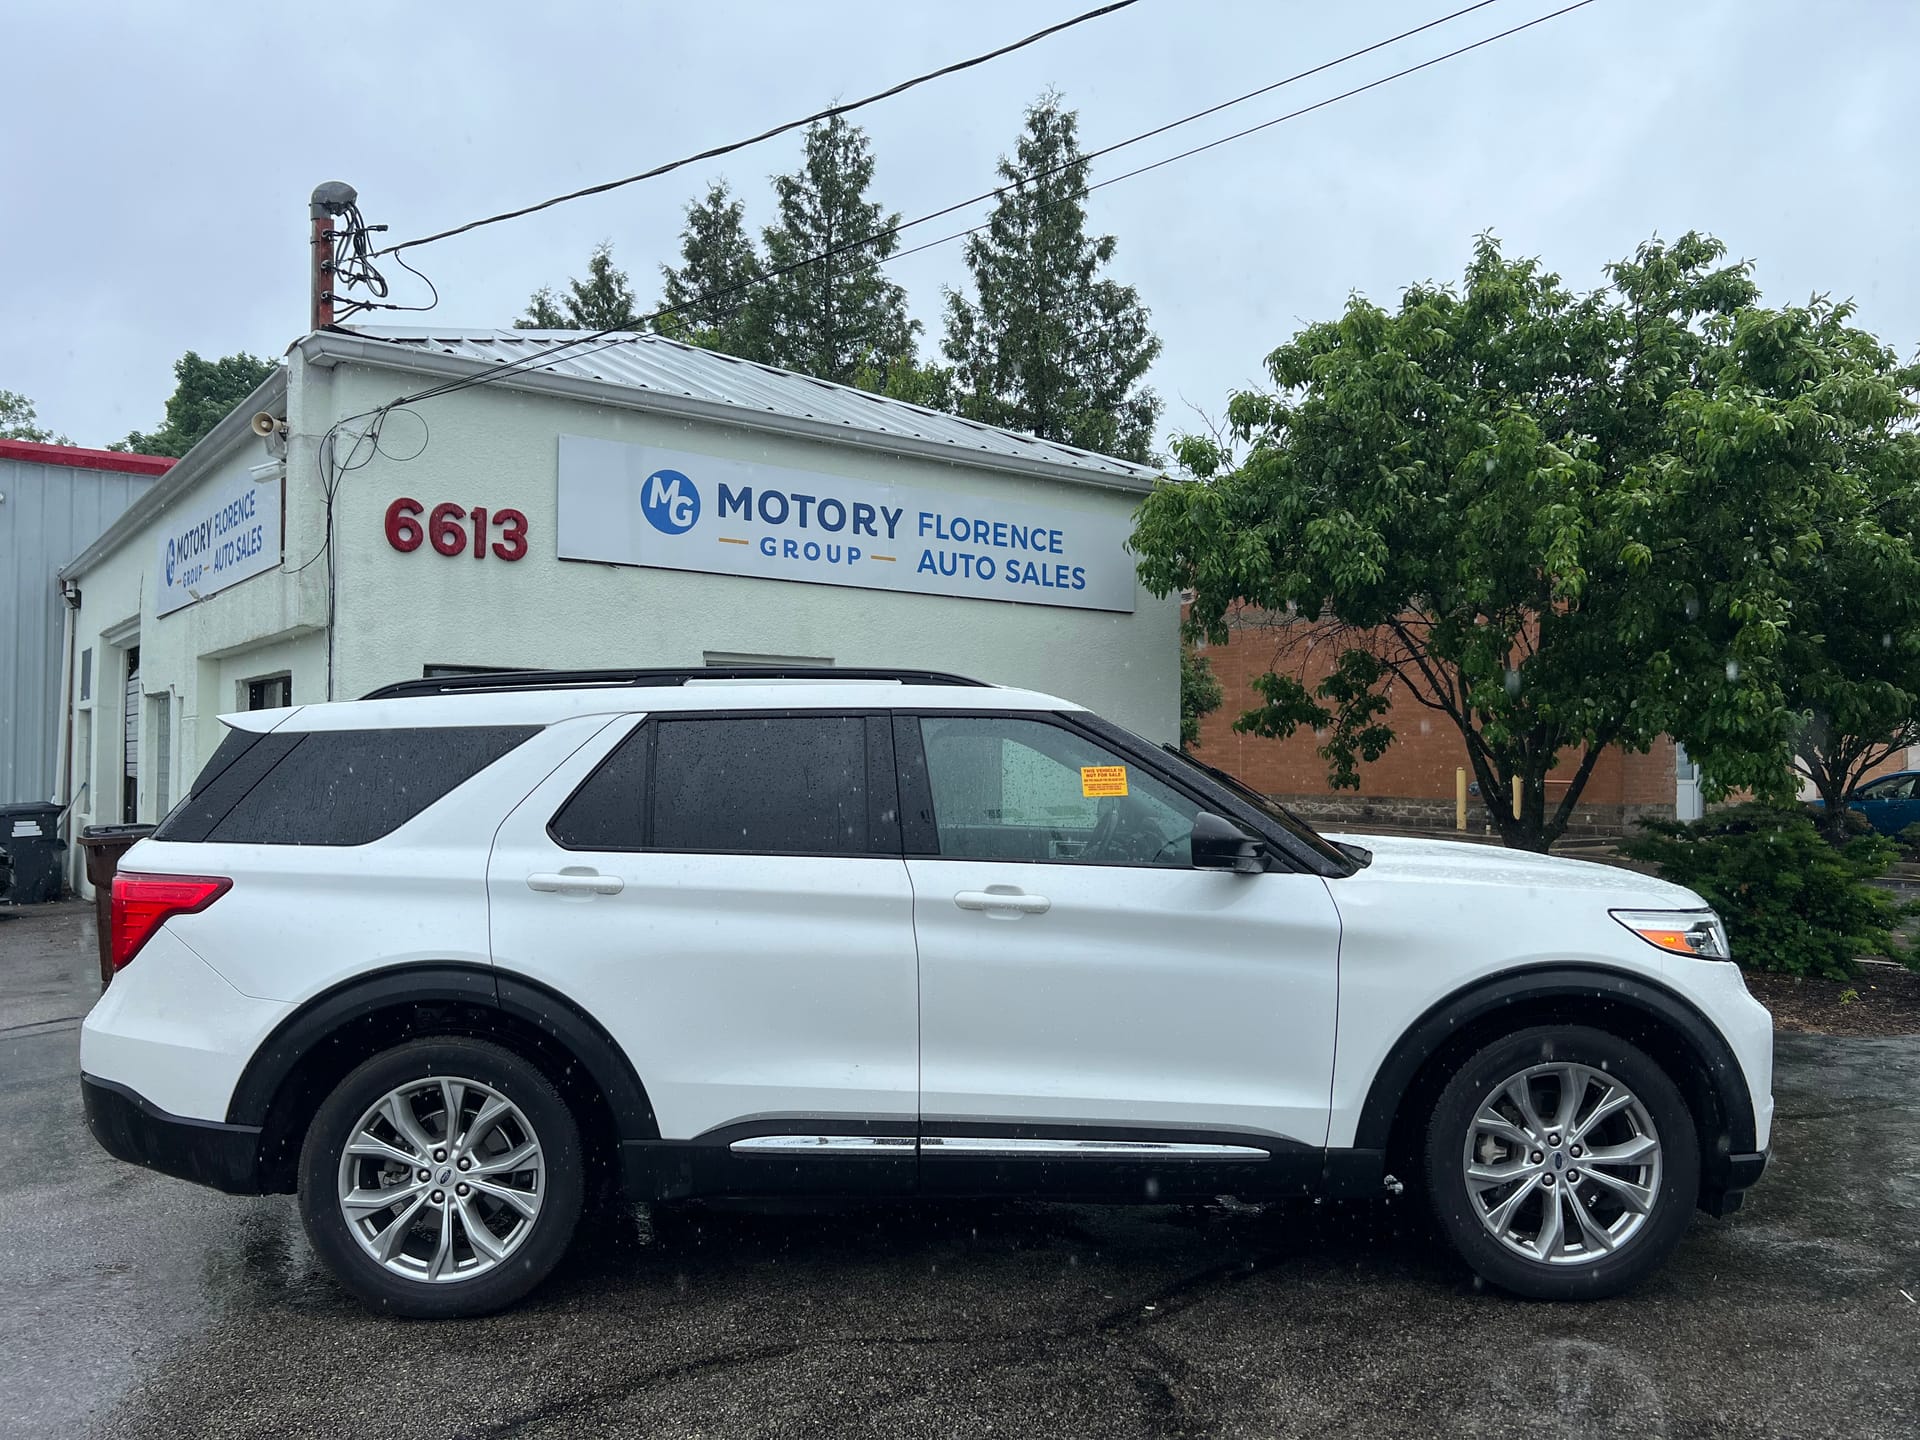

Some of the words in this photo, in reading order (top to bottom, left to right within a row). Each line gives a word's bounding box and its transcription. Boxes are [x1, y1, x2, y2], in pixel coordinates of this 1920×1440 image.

[214, 489, 256, 538] FLORENCE
[648, 476, 694, 527] MG
[718, 483, 904, 539] MOTORY
[176, 517, 213, 565] MOTORY
[213, 540, 234, 574] AUTO
[236, 525, 263, 562] SALES
[384, 497, 529, 562] 6613
[759, 536, 862, 565] GROUP
[918, 511, 1063, 554] FLORENCE
[182, 564, 203, 588] GROUP
[916, 549, 996, 580] AUTO
[1005, 559, 1086, 590] SALES
